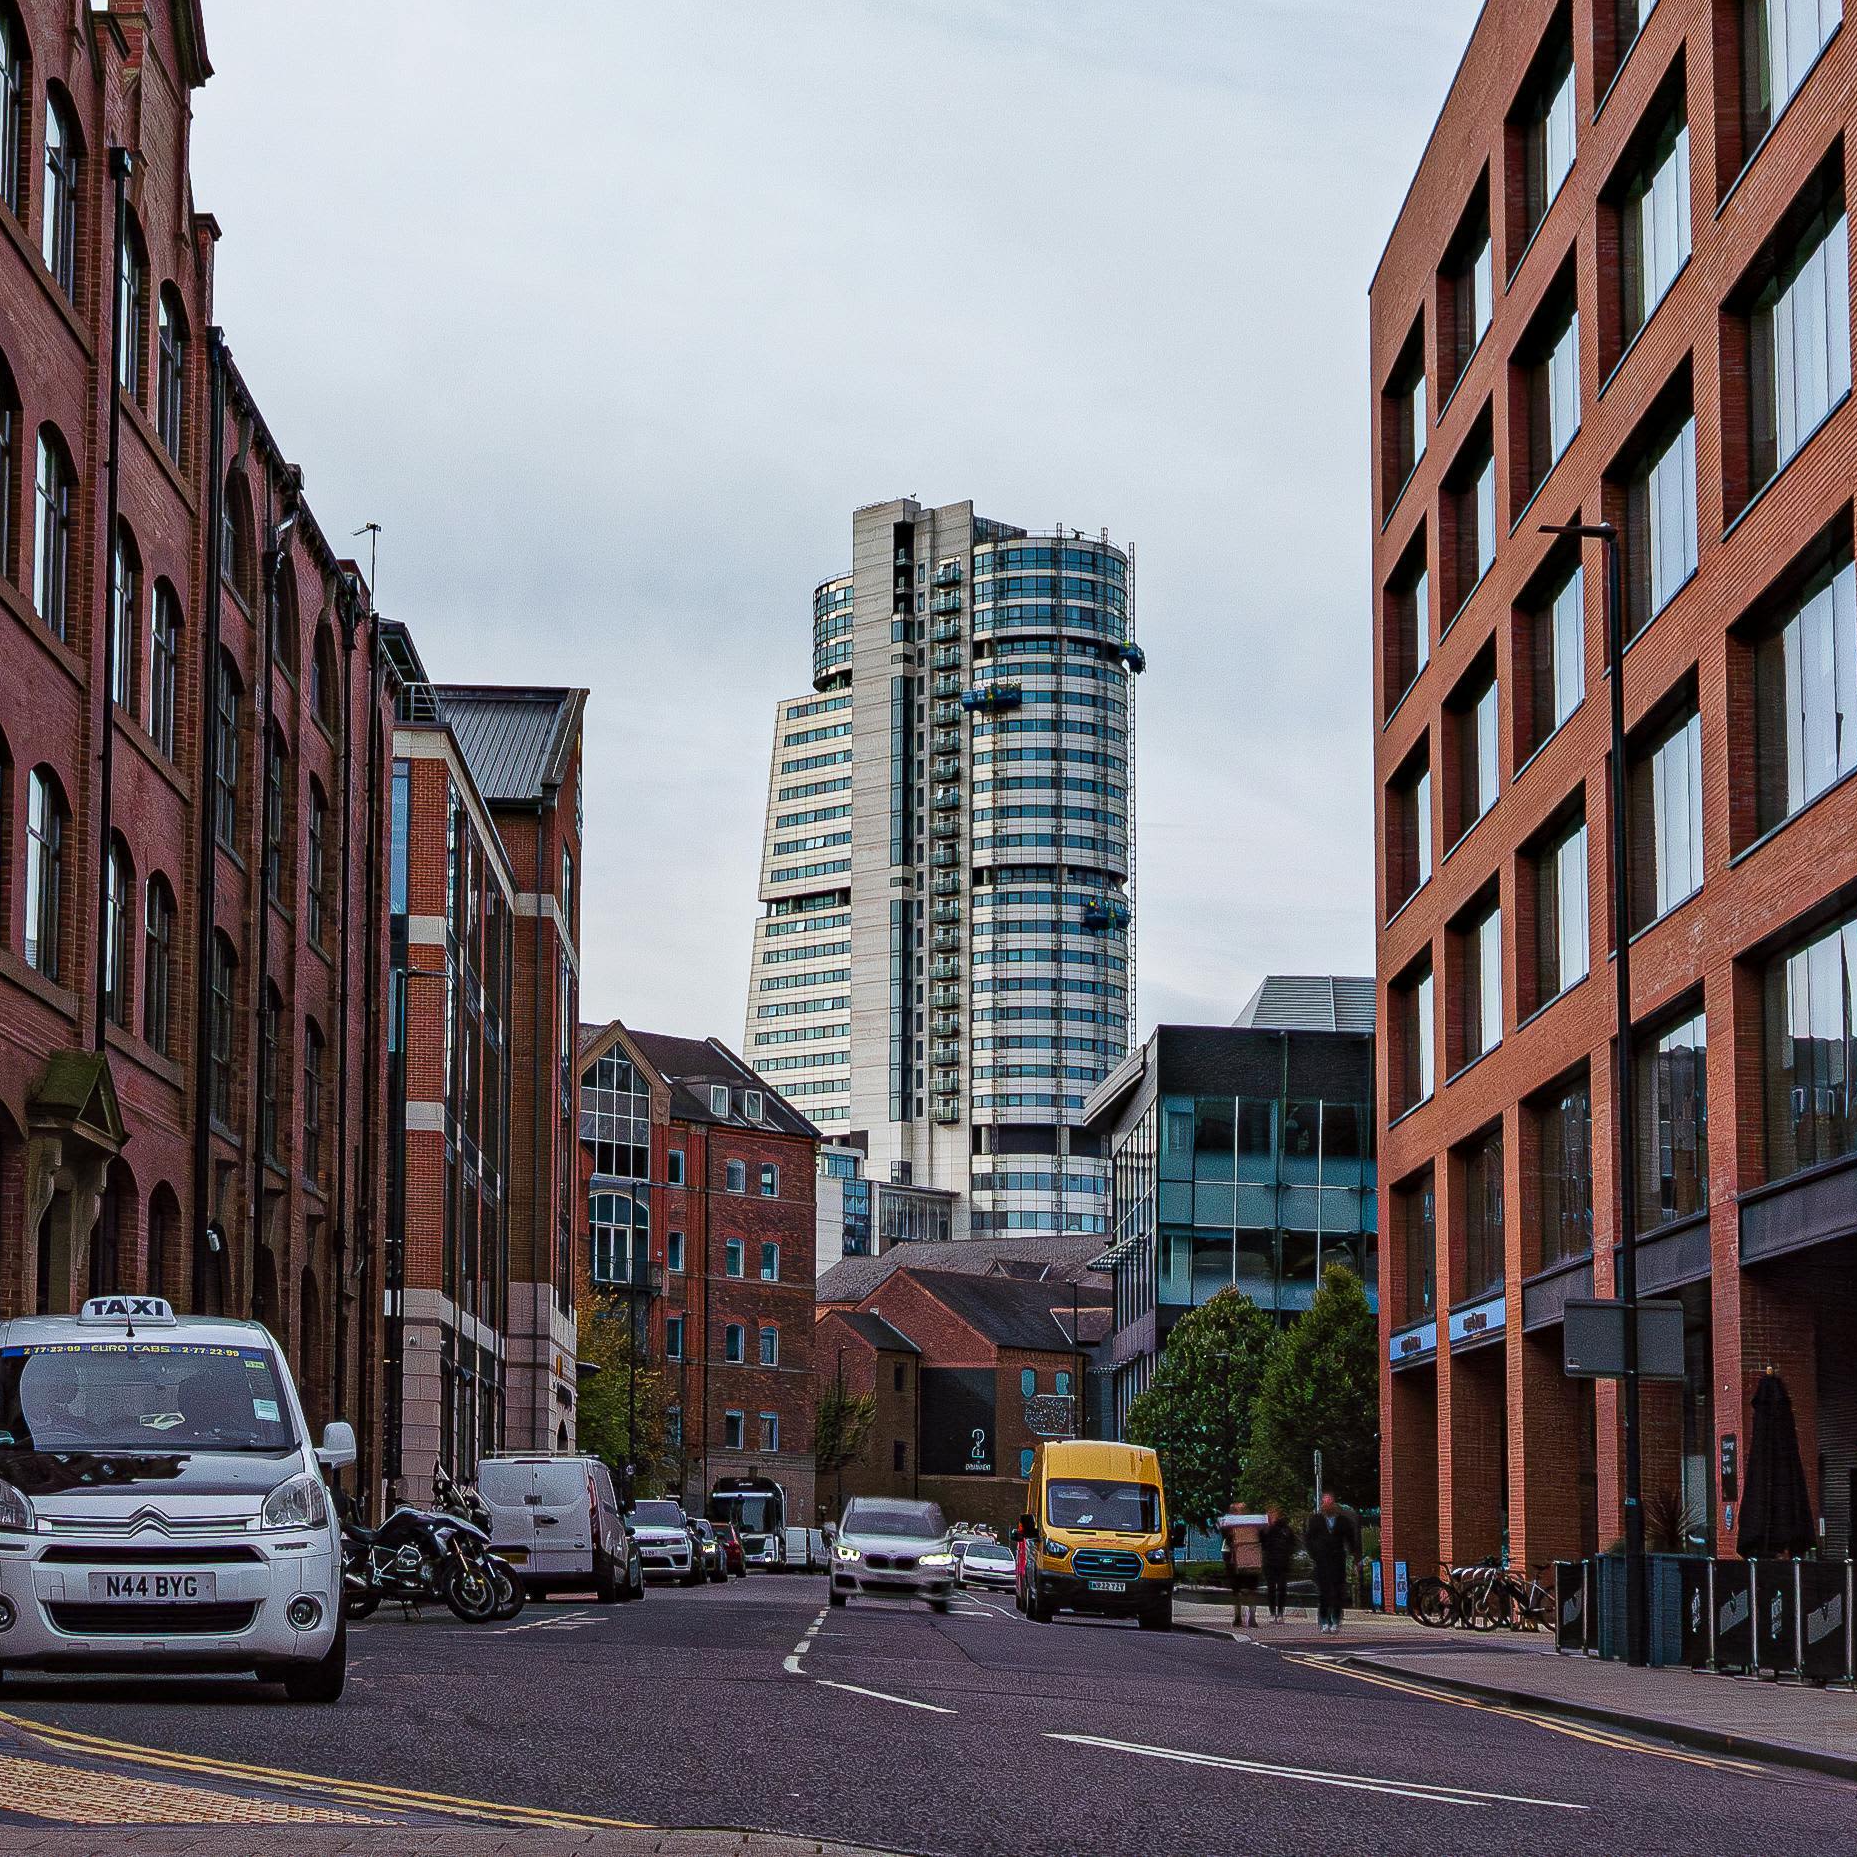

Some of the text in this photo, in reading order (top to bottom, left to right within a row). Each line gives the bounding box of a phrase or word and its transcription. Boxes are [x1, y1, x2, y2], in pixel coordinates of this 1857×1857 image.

[90, 1299, 164, 1317] TAXI
[91, 1344, 128, 1352] EURO
[133, 1344, 170, 1353] CABS
[107, 1575, 198, 1598] N44 BYG
